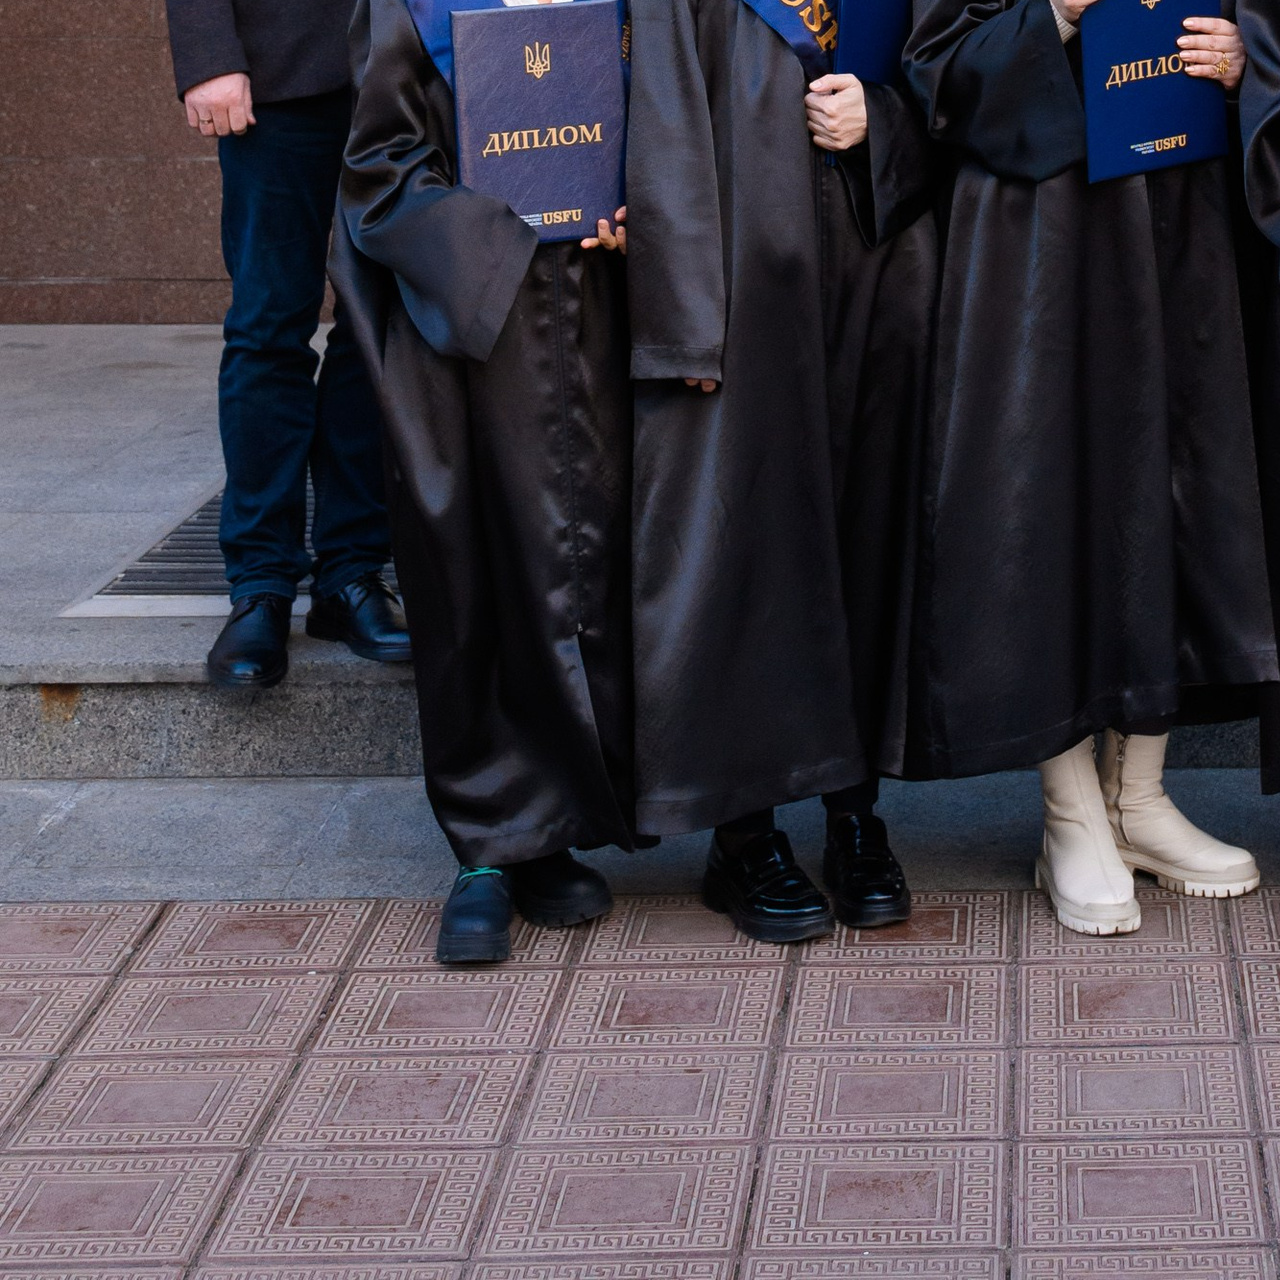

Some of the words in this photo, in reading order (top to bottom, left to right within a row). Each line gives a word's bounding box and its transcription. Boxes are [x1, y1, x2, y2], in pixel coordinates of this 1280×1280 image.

[1105, 53, 1184, 91] ДИПЛО
[482, 122, 603, 158] ДИПЛОМ
[1154, 134, 1187, 152] USFU
[542, 208, 583, 225] USFU
